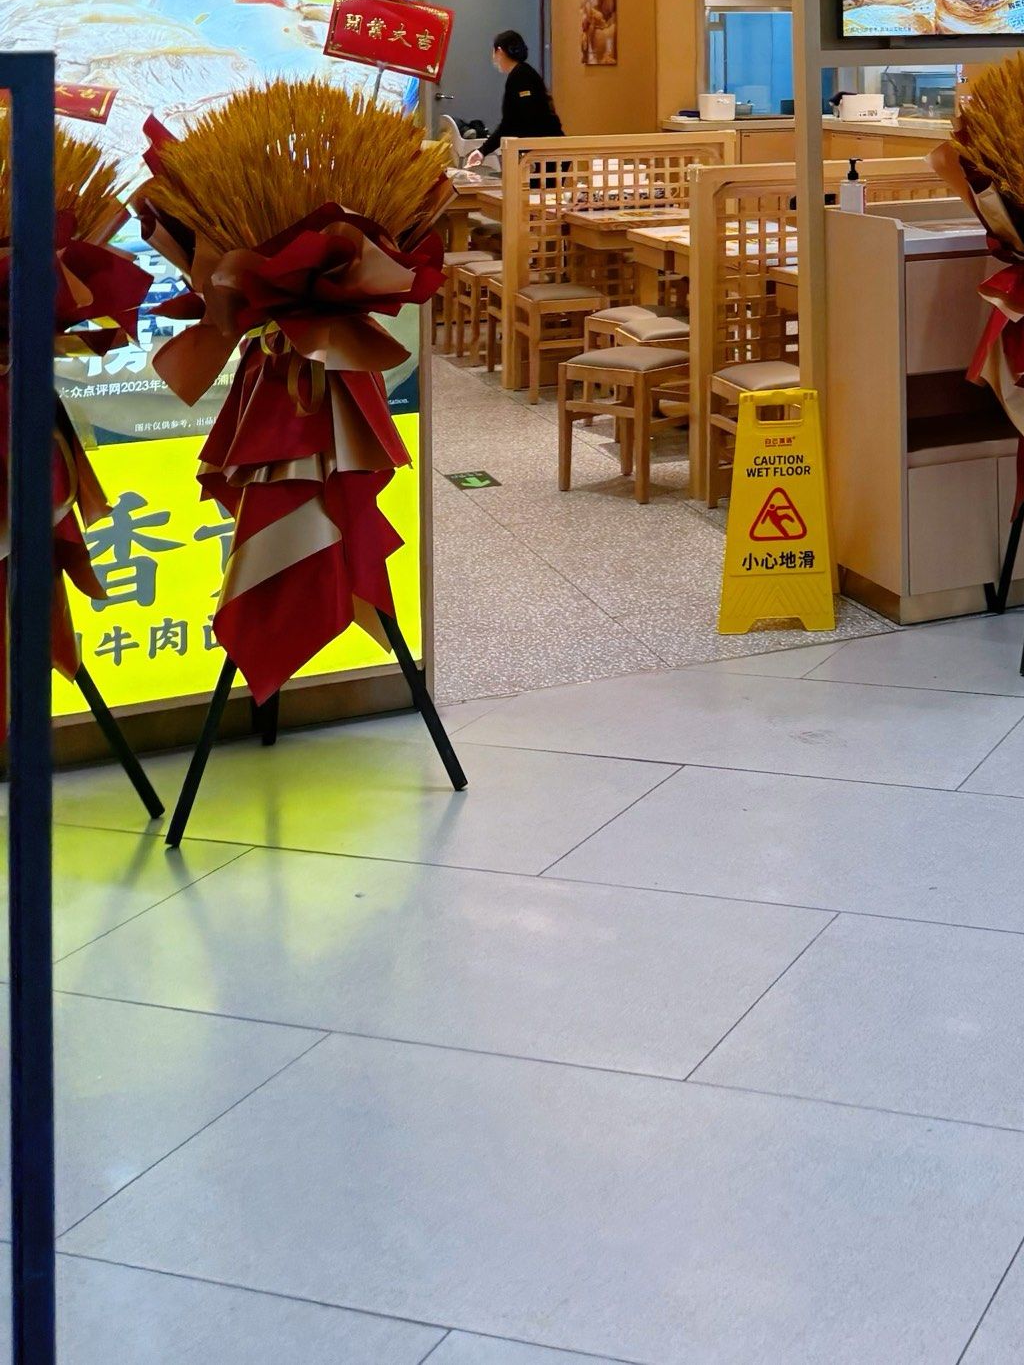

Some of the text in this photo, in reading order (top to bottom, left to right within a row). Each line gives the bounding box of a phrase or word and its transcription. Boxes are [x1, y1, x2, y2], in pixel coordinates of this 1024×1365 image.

[754, 455, 803, 466] CAUTION
[746, 466, 811, 478] WET FLOOR
[742, 550, 815, 571] 小心地滑
